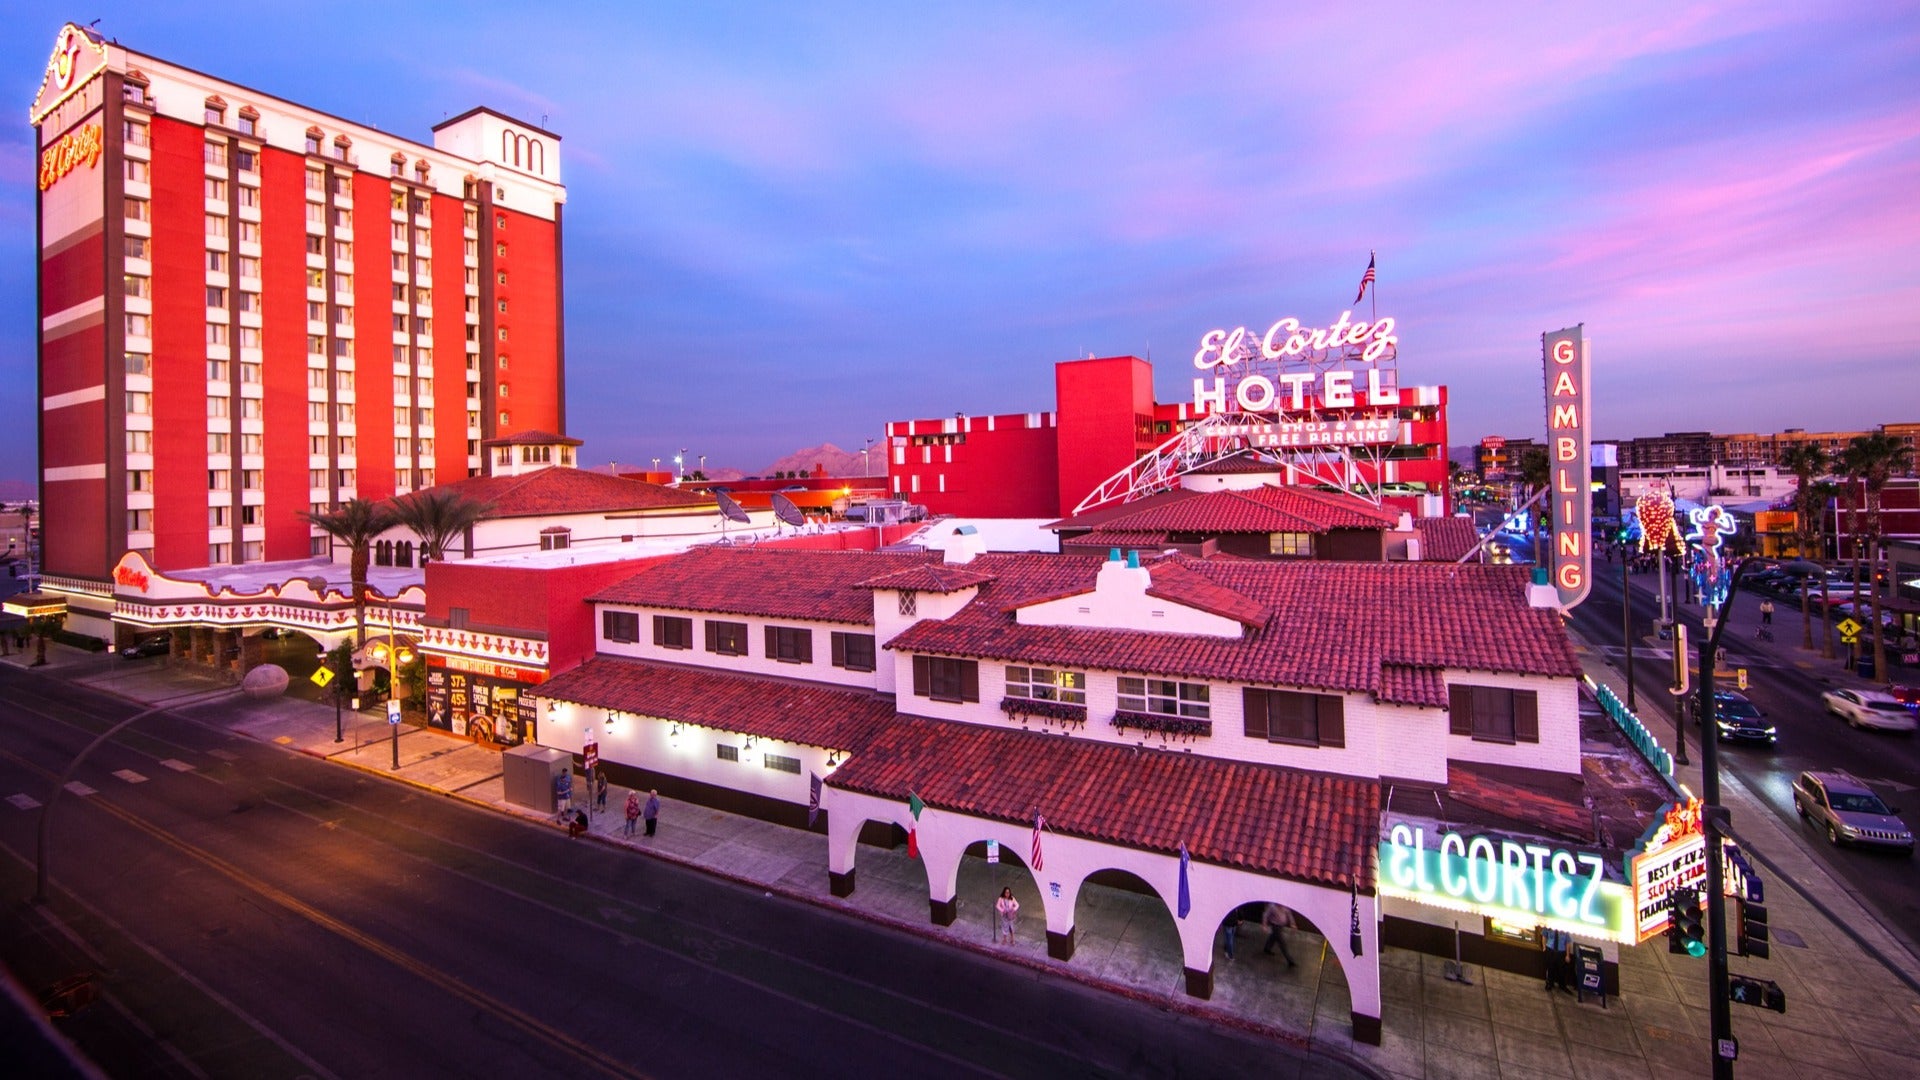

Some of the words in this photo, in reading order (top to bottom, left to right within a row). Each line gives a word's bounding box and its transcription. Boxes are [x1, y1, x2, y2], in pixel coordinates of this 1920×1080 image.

[40, 144, 61, 192] El
[57, 124, 102, 178] Cortez
[1194, 326, 1245, 369] El
[1261, 310, 1398, 362] Cortez
[1193, 368, 1400, 414] HOTEL
[1205, 424, 1272, 436] COFFEE
[1281, 422, 1328, 433] SHOP
[1336, 421, 1348, 431] &
[1355, 420, 1391, 430] BAR
[1257, 433, 1300, 446] FREE
[1308, 430, 1389, 443] PARKING
[1552, 339, 1583, 589] GAMBLING
[1390, 823, 1435, 893] EL
[1439, 830, 1606, 925] CORTEZ
[1648, 863, 1670, 884] BEST
[1673, 856, 1682, 871] OF
[1685, 849, 1697, 865] LV
[1648, 877, 1676, 900] SLOTS
